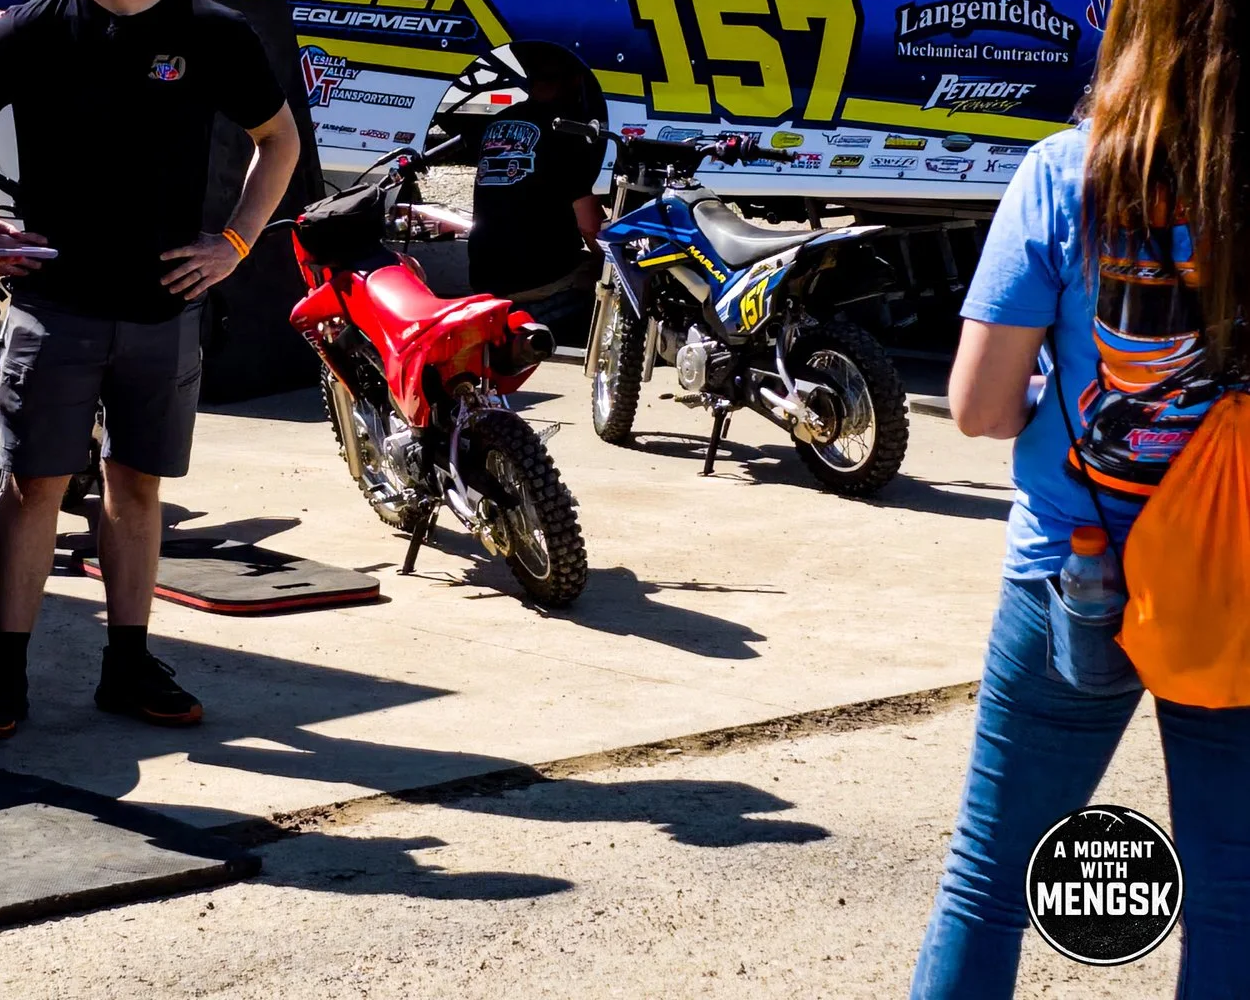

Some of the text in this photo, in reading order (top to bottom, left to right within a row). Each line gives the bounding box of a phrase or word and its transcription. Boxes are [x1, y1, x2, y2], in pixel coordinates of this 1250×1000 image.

[292, 7, 462, 34] EQUIPMENT
[897, 41, 1069, 63] Mechanical Contractors
[921, 73, 1037, 110] PETROFF
[739, 276, 770, 332] 157
